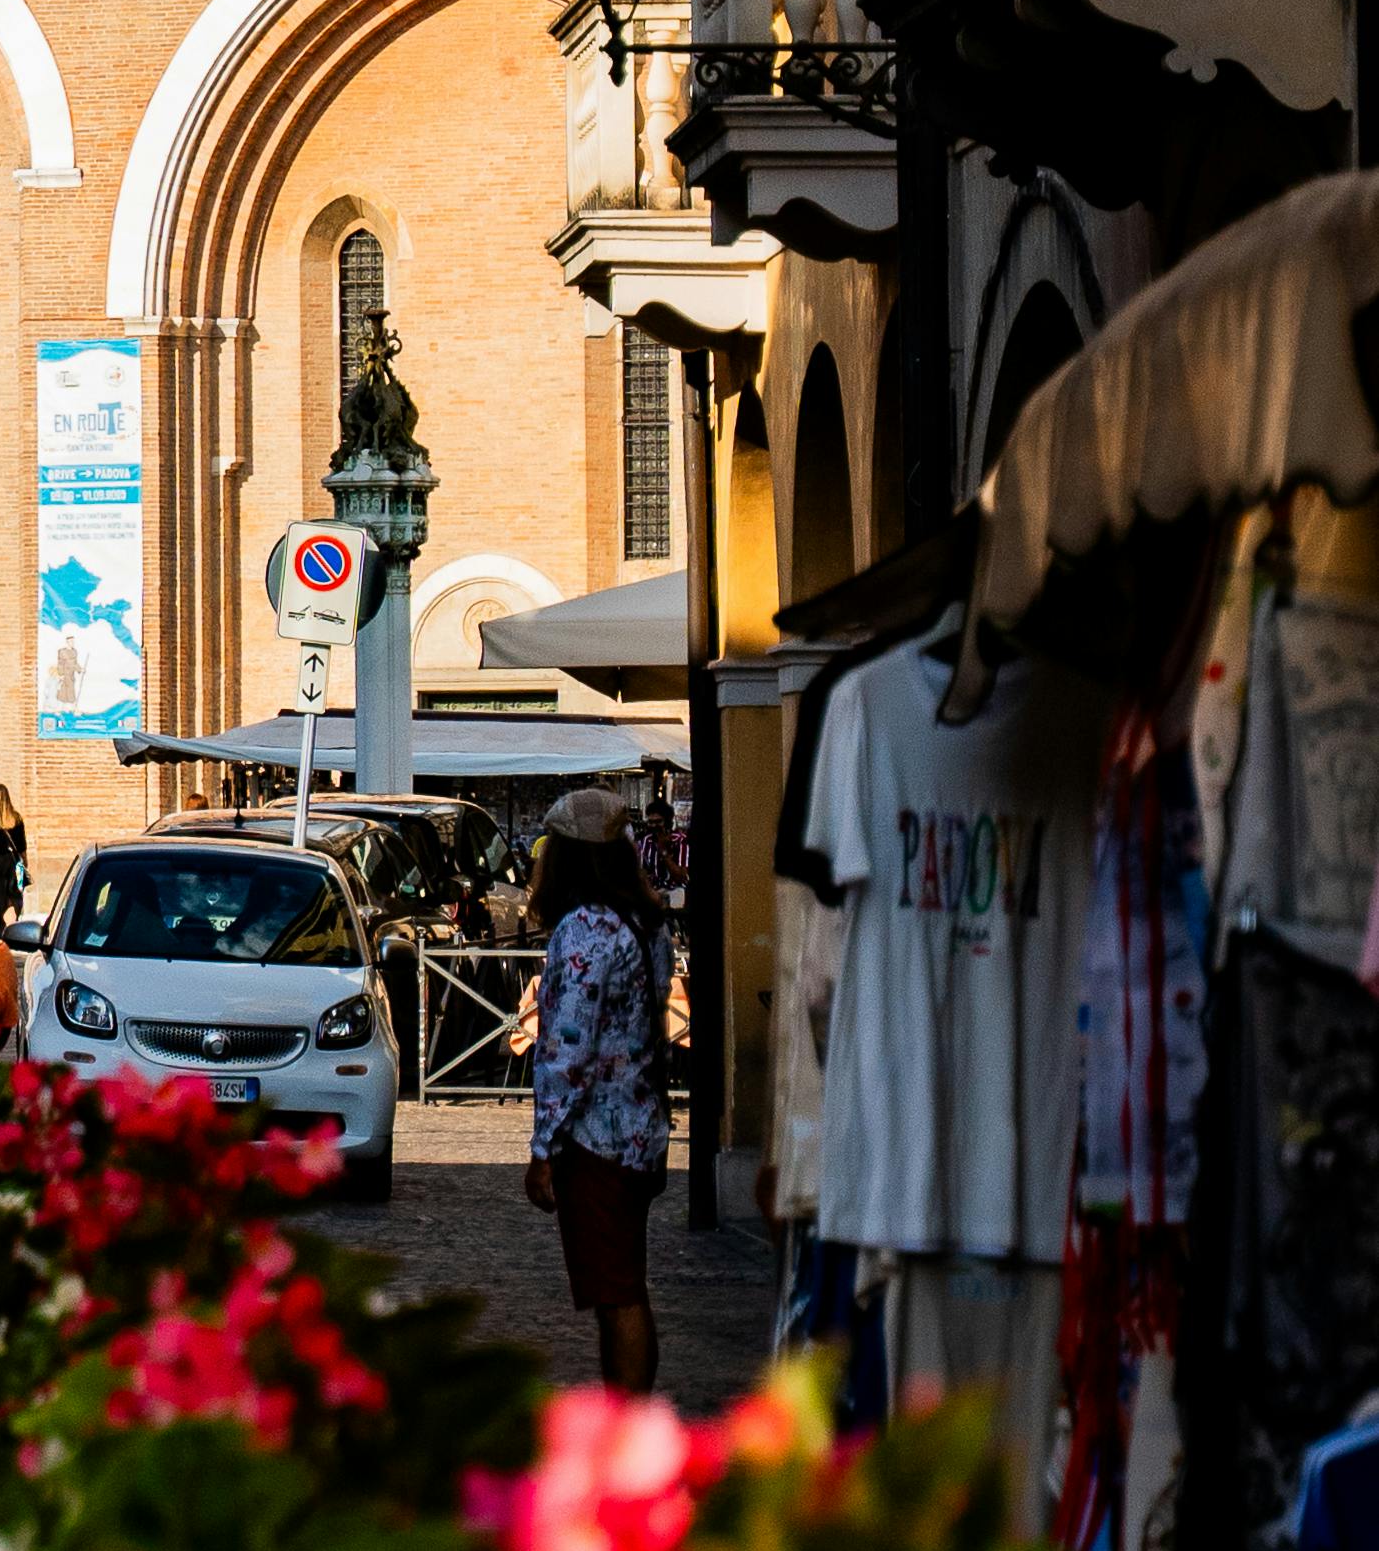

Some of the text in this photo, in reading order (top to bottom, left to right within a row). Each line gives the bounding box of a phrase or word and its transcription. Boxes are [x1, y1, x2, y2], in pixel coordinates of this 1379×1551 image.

[54, 402, 126, 435] EN ROUTE
[48, 467, 131, 481] BRIVE PADOVA
[897, 807, 1047, 918] PADOVA
